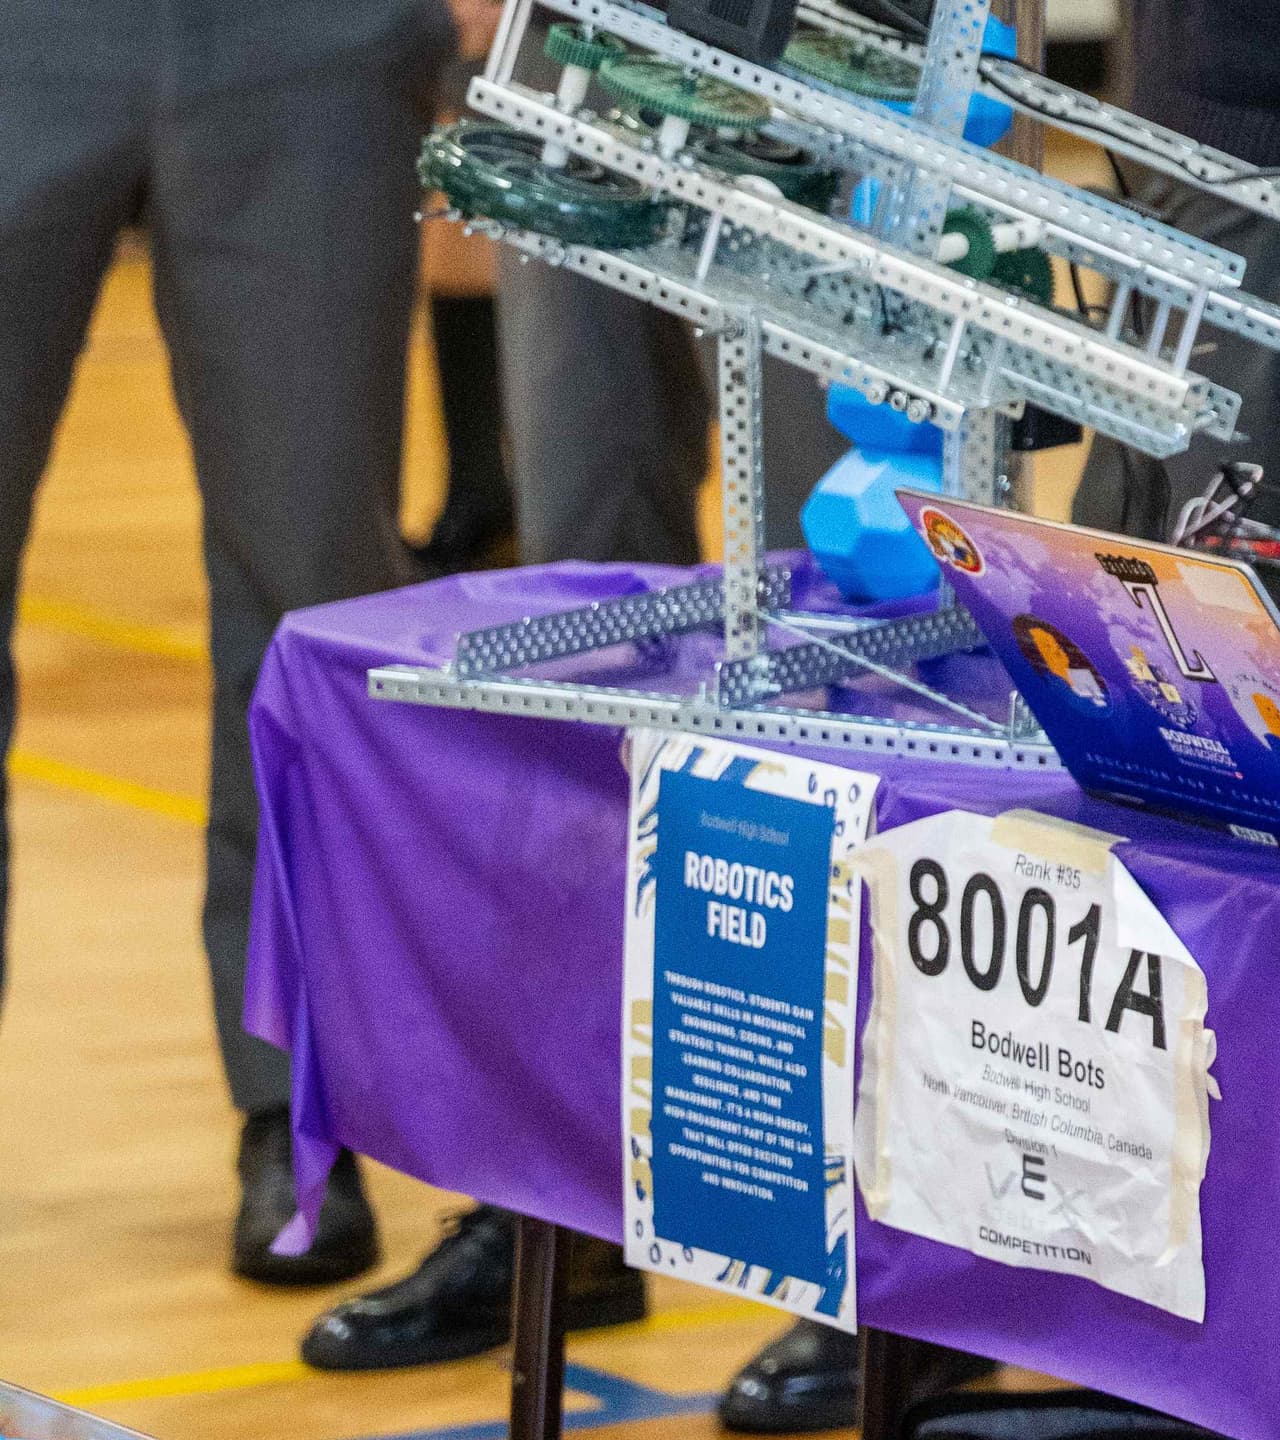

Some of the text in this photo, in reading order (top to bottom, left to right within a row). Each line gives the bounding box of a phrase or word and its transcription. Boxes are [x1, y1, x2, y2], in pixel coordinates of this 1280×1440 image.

[684, 850, 794, 912] ROBOTICS
[1015, 854, 1081, 890] Rank #35
[707, 901, 767, 949] FIELD
[908, 858, 1167, 1050] 8001A
[971, 1020, 1105, 1090] Bodwell Bots
[982, 1064, 1091, 1112] Bodwell High School
[923, 1073, 949, 1095] North
[1012, 1103, 1047, 1128] British
[1108, 1134, 1153, 1160] Canada
[1005, 1128, 1058, 1159] Division 1
[984, 1154, 1086, 1224] VEX
[979, 1226, 1092, 1264] COMPETITION
